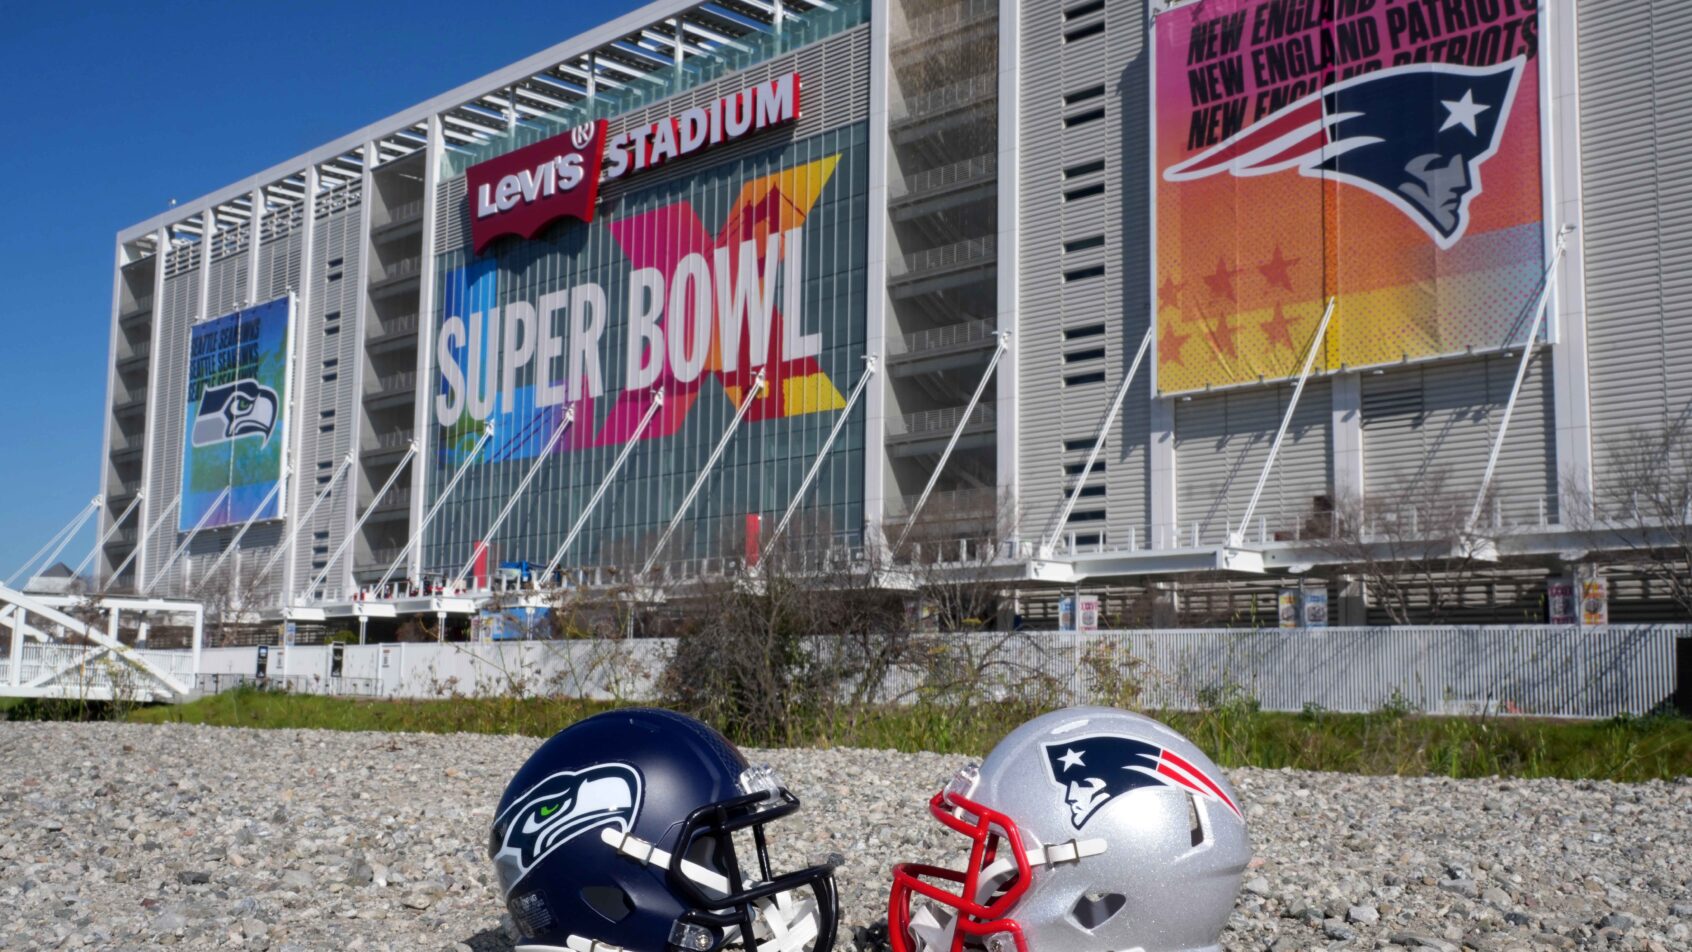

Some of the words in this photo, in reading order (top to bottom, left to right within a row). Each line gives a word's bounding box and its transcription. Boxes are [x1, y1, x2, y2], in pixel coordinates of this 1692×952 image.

[1187, 9, 1247, 66] NEW
[1188, 54, 1245, 107] NEW
[1250, 16, 1380, 88] ENGLAND
[1386, 0, 1537, 50] PATRIO
[606, 72, 797, 180] STADIUM
[1187, 96, 1249, 151] NEW
[435, 282, 607, 427] SUPER
[626, 227, 823, 393] BOWL
